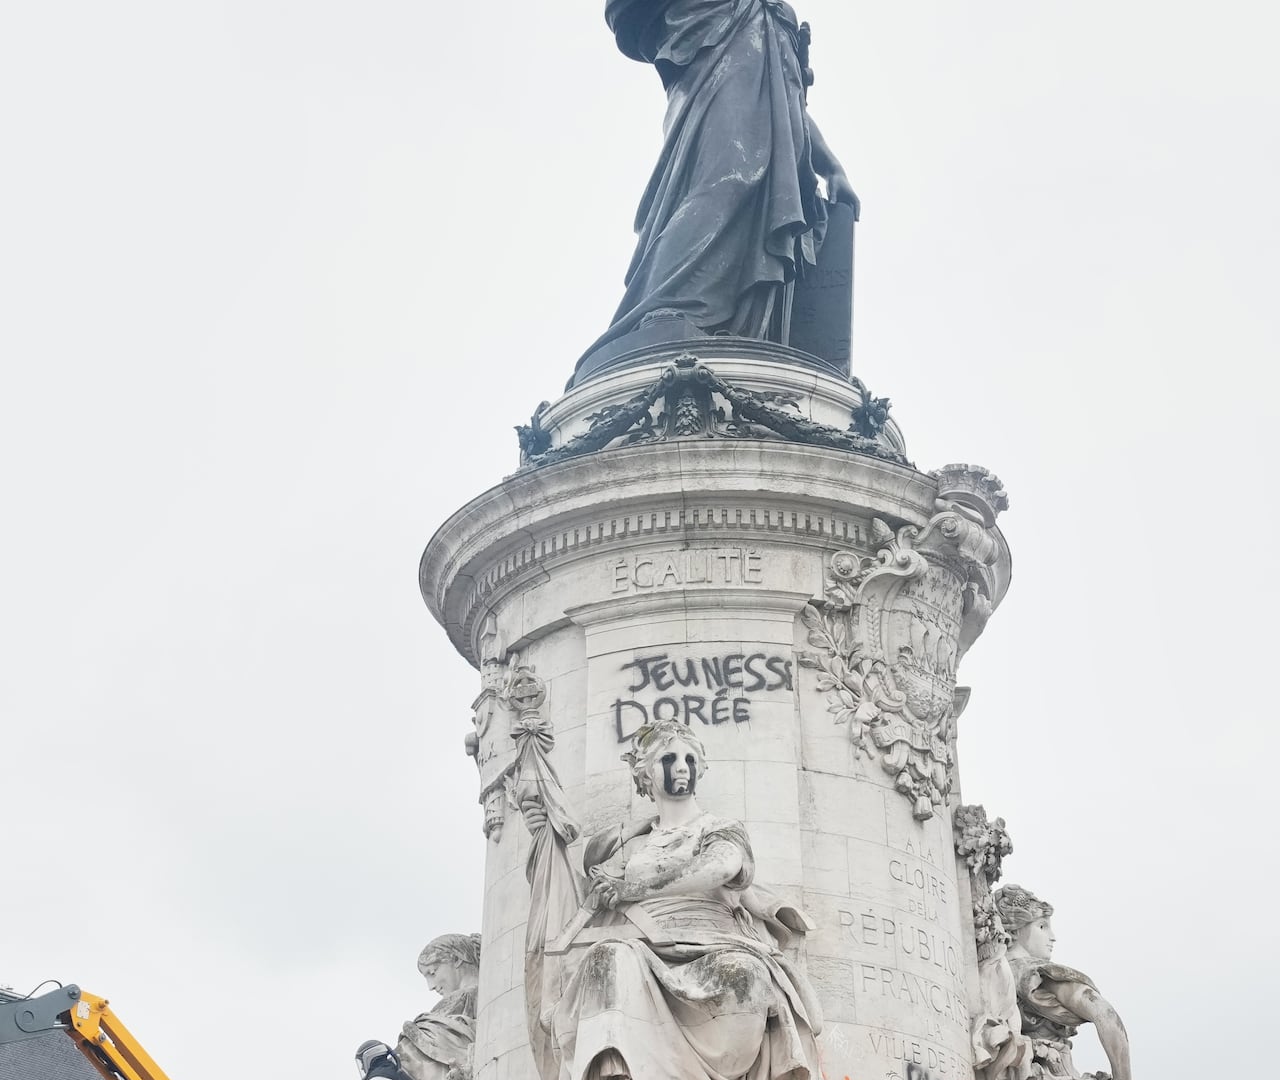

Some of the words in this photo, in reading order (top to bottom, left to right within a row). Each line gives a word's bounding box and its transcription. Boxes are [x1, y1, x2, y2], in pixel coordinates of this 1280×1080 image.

[612, 551, 762, 594] ÉGALITÉ
[610, 688, 751, 742] DORÉE
[889, 860, 947, 904] GLOIRE
[869, 1032, 921, 1064] VILLE
[927, 1047, 946, 1071] DE
